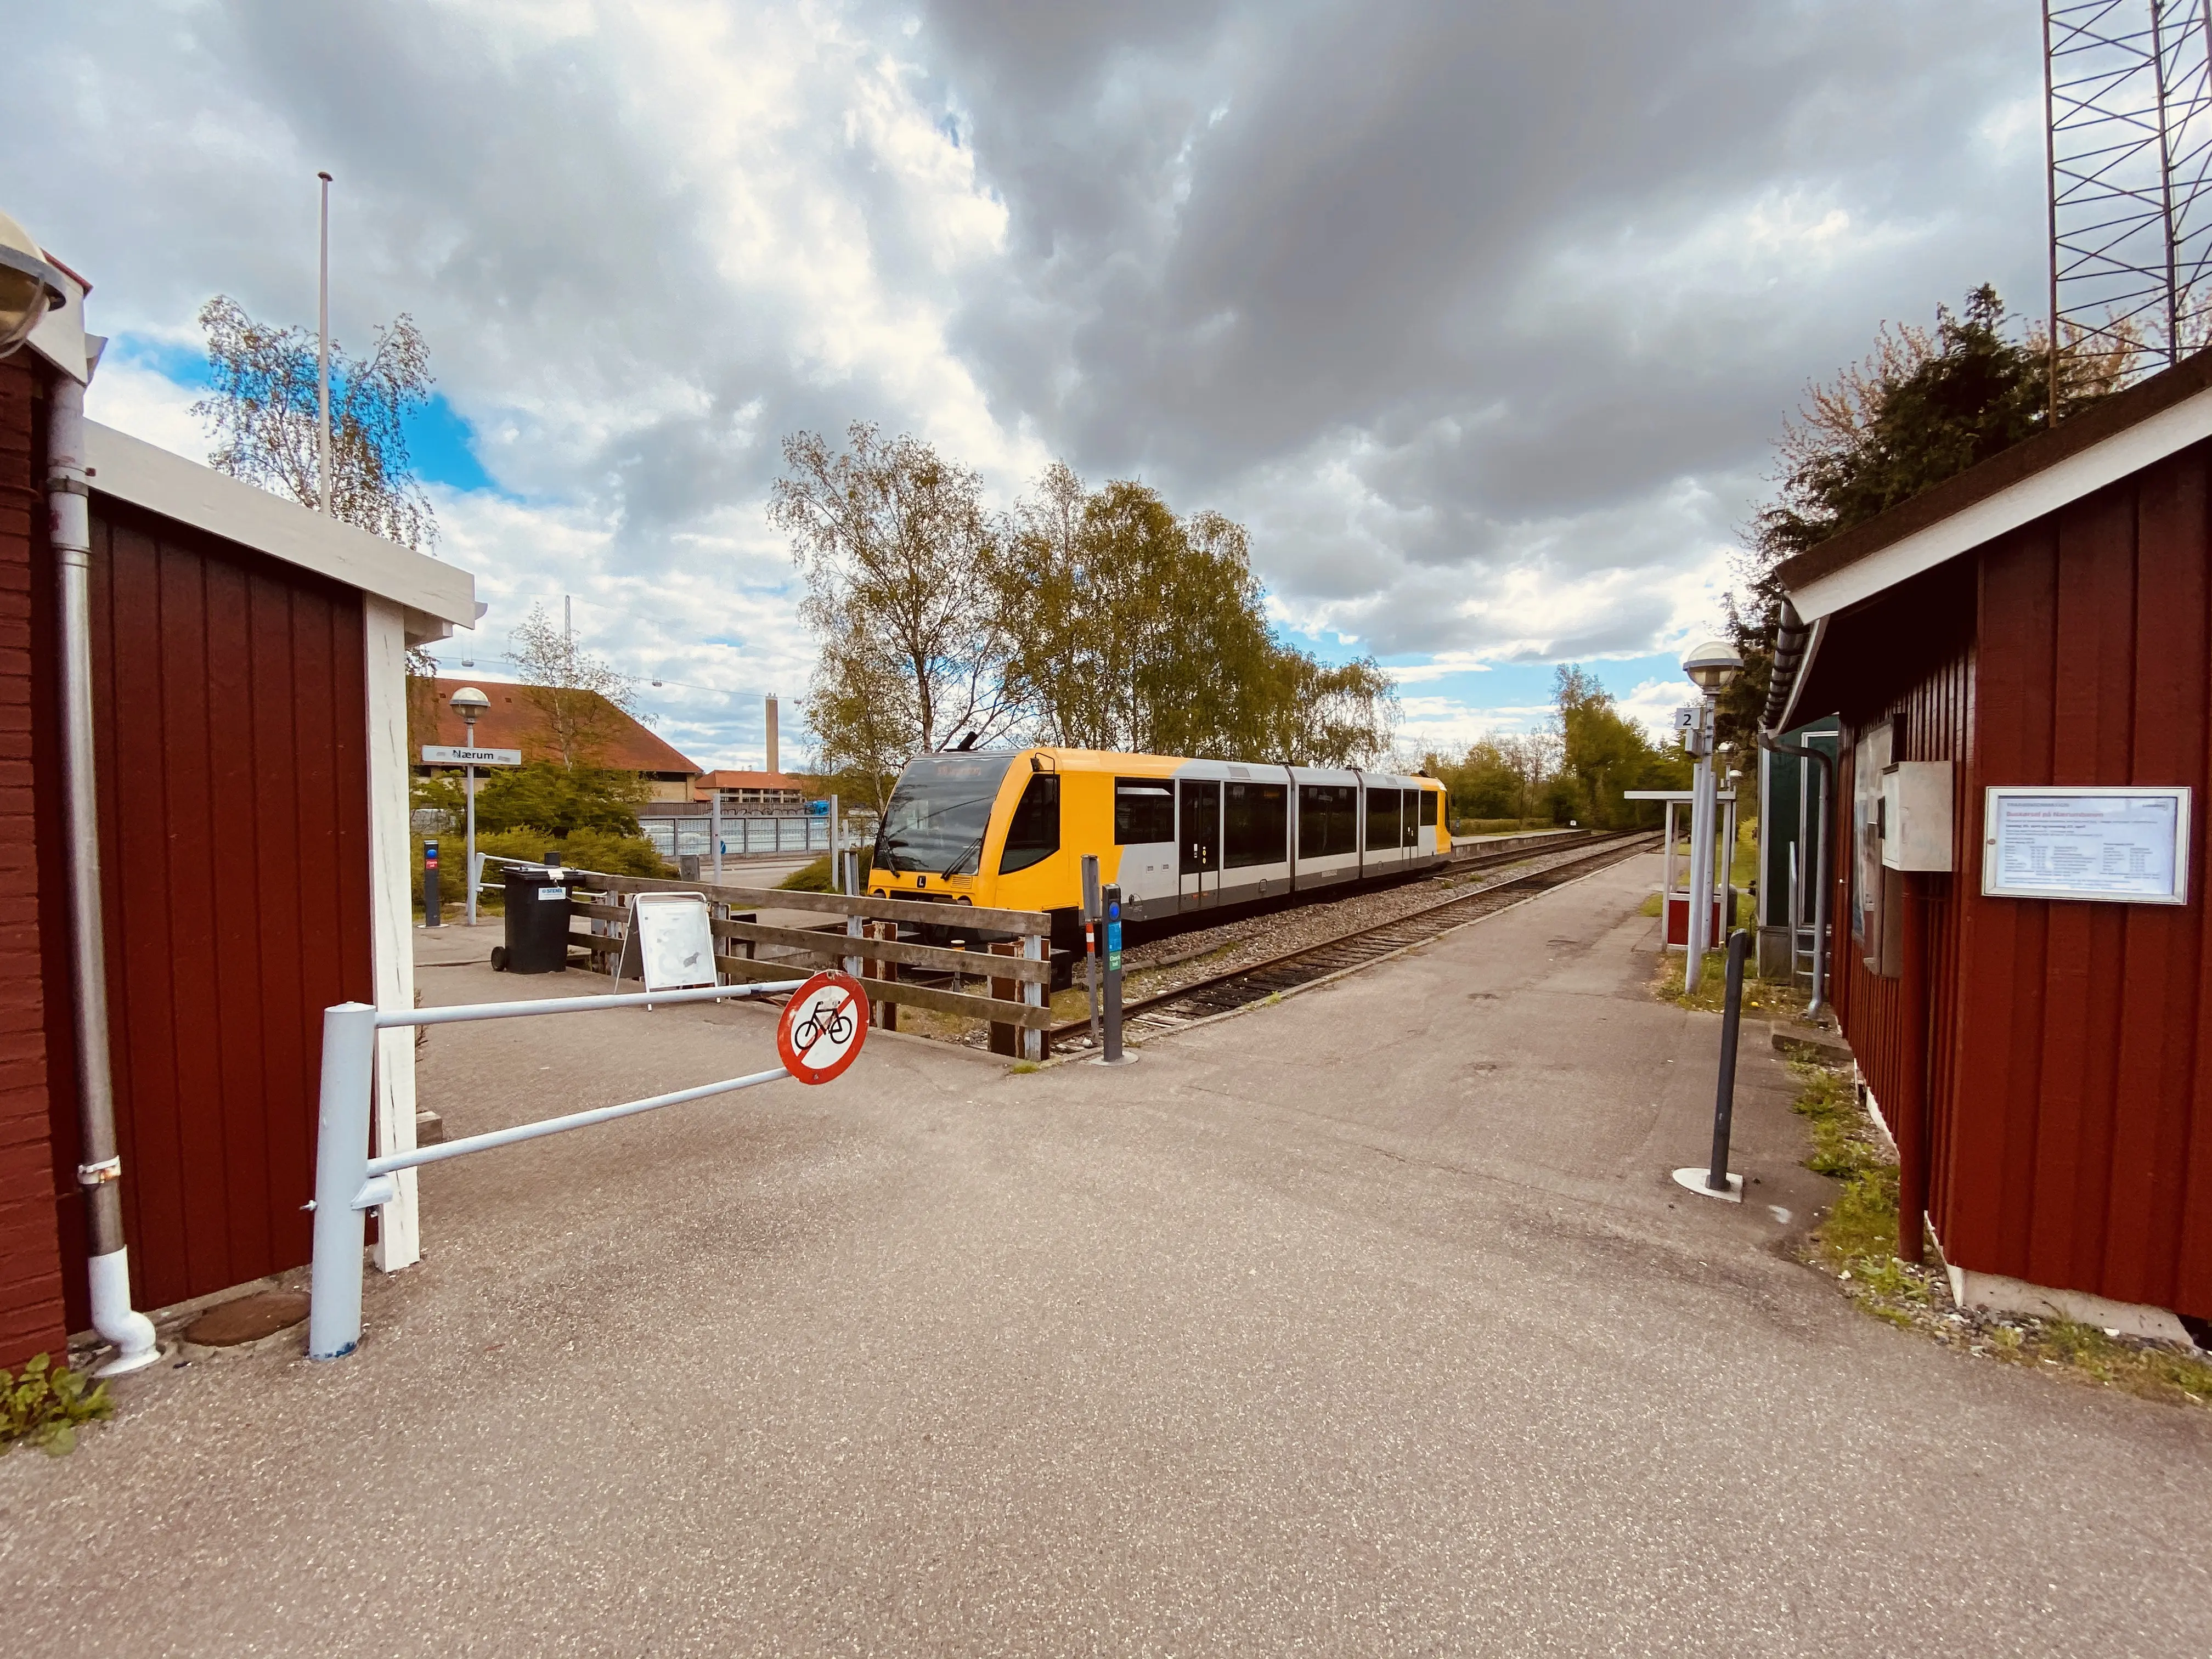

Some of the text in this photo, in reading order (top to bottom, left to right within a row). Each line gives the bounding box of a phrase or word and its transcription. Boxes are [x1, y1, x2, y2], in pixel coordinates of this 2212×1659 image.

[1683, 714, 1691, 726] 2
[453, 749, 494, 759] Nærum
[919, 877, 924, 886] L
